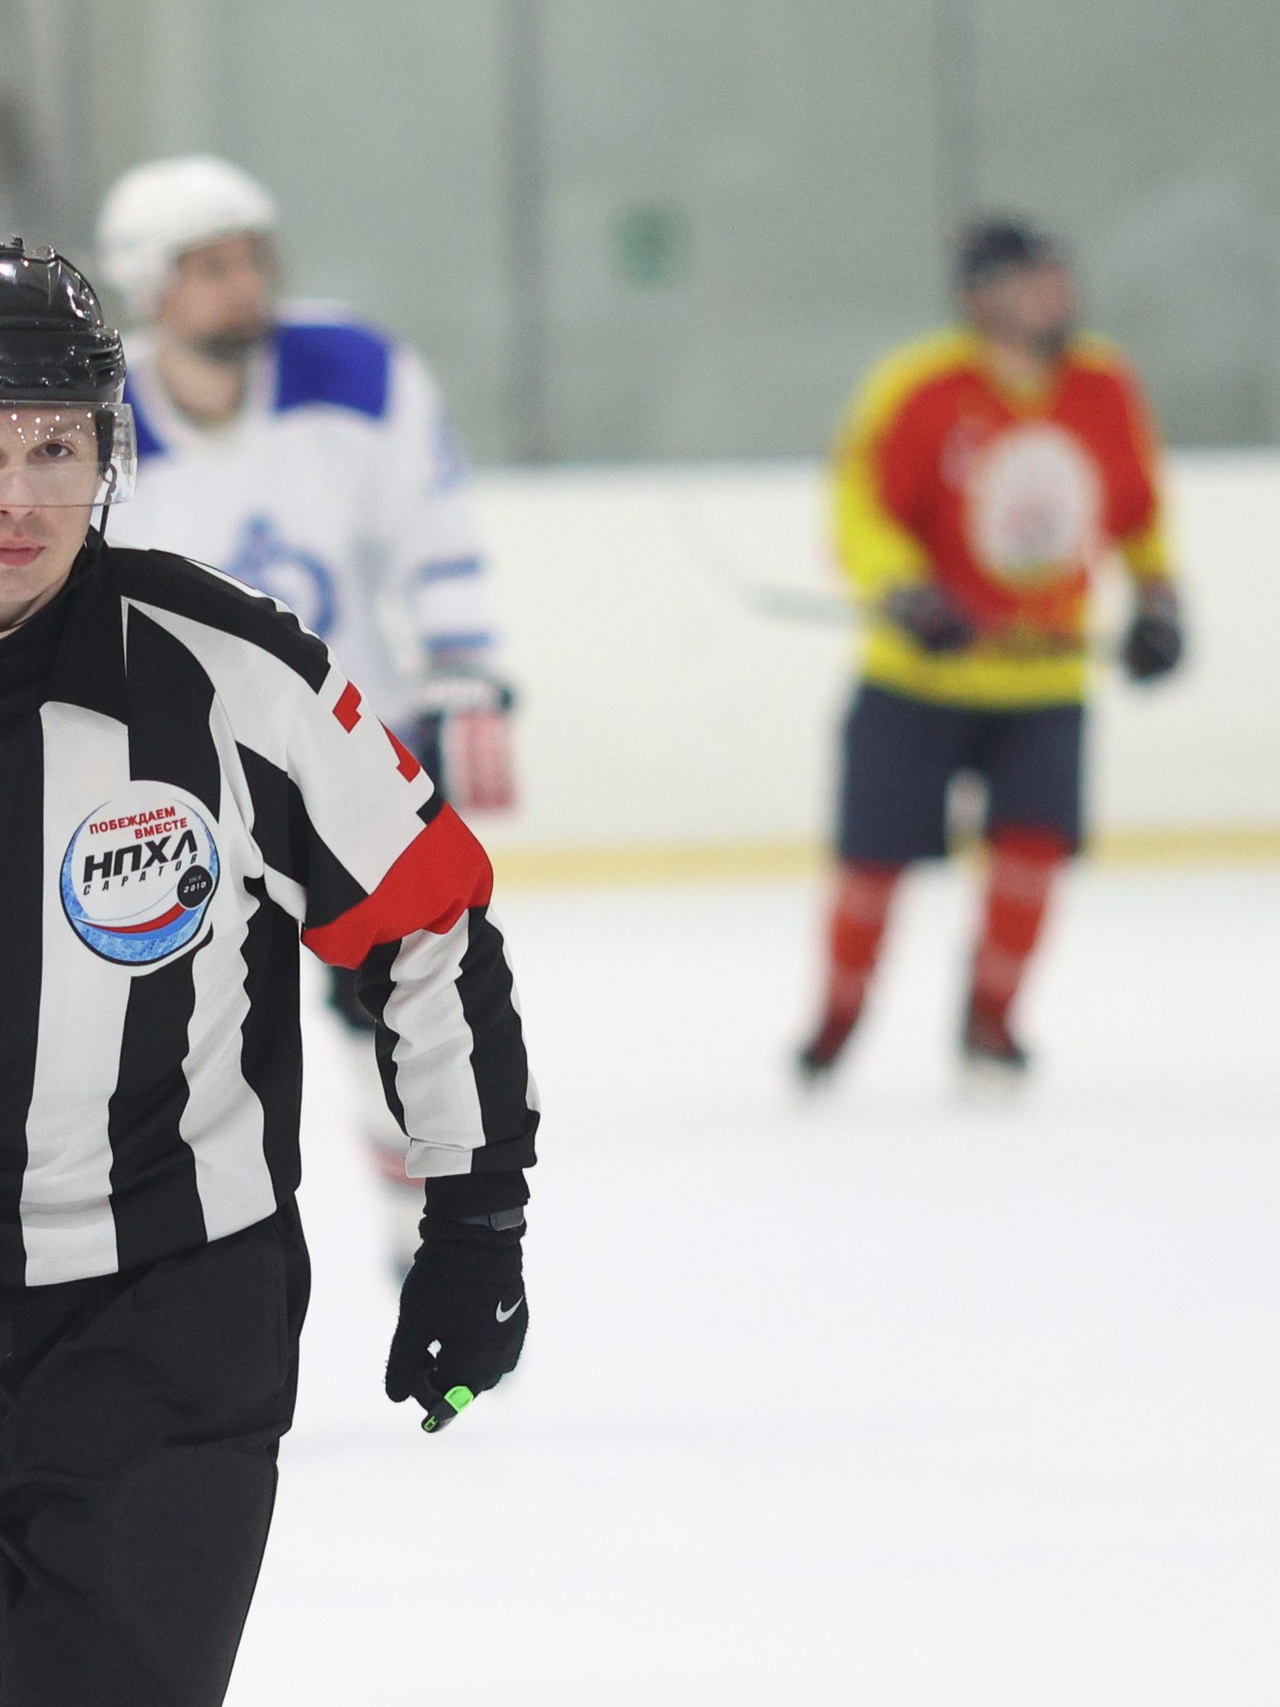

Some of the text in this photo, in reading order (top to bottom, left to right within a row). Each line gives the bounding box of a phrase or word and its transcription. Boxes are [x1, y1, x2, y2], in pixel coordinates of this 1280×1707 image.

[89, 806, 176, 834] ПОБЕЖДАЕМ
[134, 817, 188, 839] ВМЕСТЕ
[83, 829, 198, 883] НПХЛ
[83, 853, 198, 895] САРАТОВ
[183, 881, 207, 894] 2010
